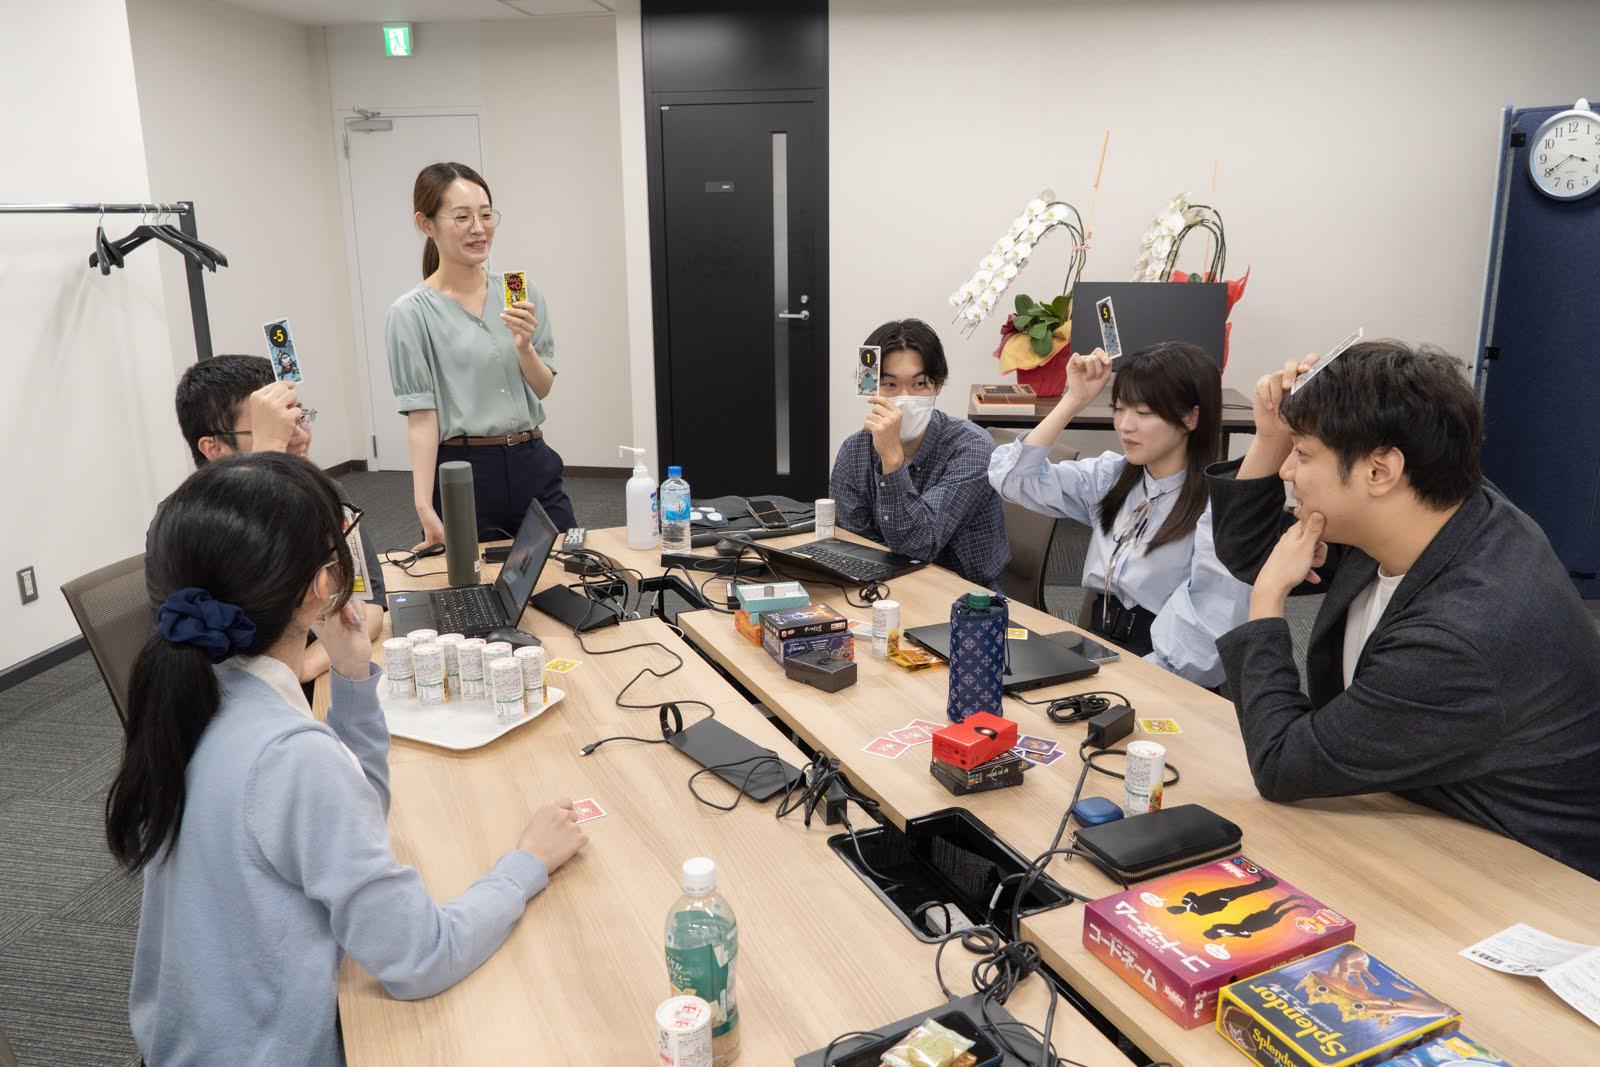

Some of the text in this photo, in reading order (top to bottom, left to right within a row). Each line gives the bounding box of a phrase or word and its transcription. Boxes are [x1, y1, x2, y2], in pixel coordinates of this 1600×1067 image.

[1555, 127, 1563, 137] 11
[1568, 121, 1579, 133] 12
[1586, 123, 1590, 135] 1
[1544, 139, 1554, 149] 10
[1540, 153, 1547, 164] 9
[1544, 167, 1551, 178] 8
[1593, 163, 1598, 173] 4
[1554, 177, 1560, 187] 7
[1566, 180, 1574, 190] 6
[1582, 176, 1588, 186] 5
[273, 329, 284, 342] -5
[866, 353, 871, 364] 1
[1114, 900, 1212, 973] コードネーム
[1088, 922, 1158, 992] コードネーム
[1249, 984, 1348, 1057] Splendor
[1252, 1027, 1298, 1067] Splendo
